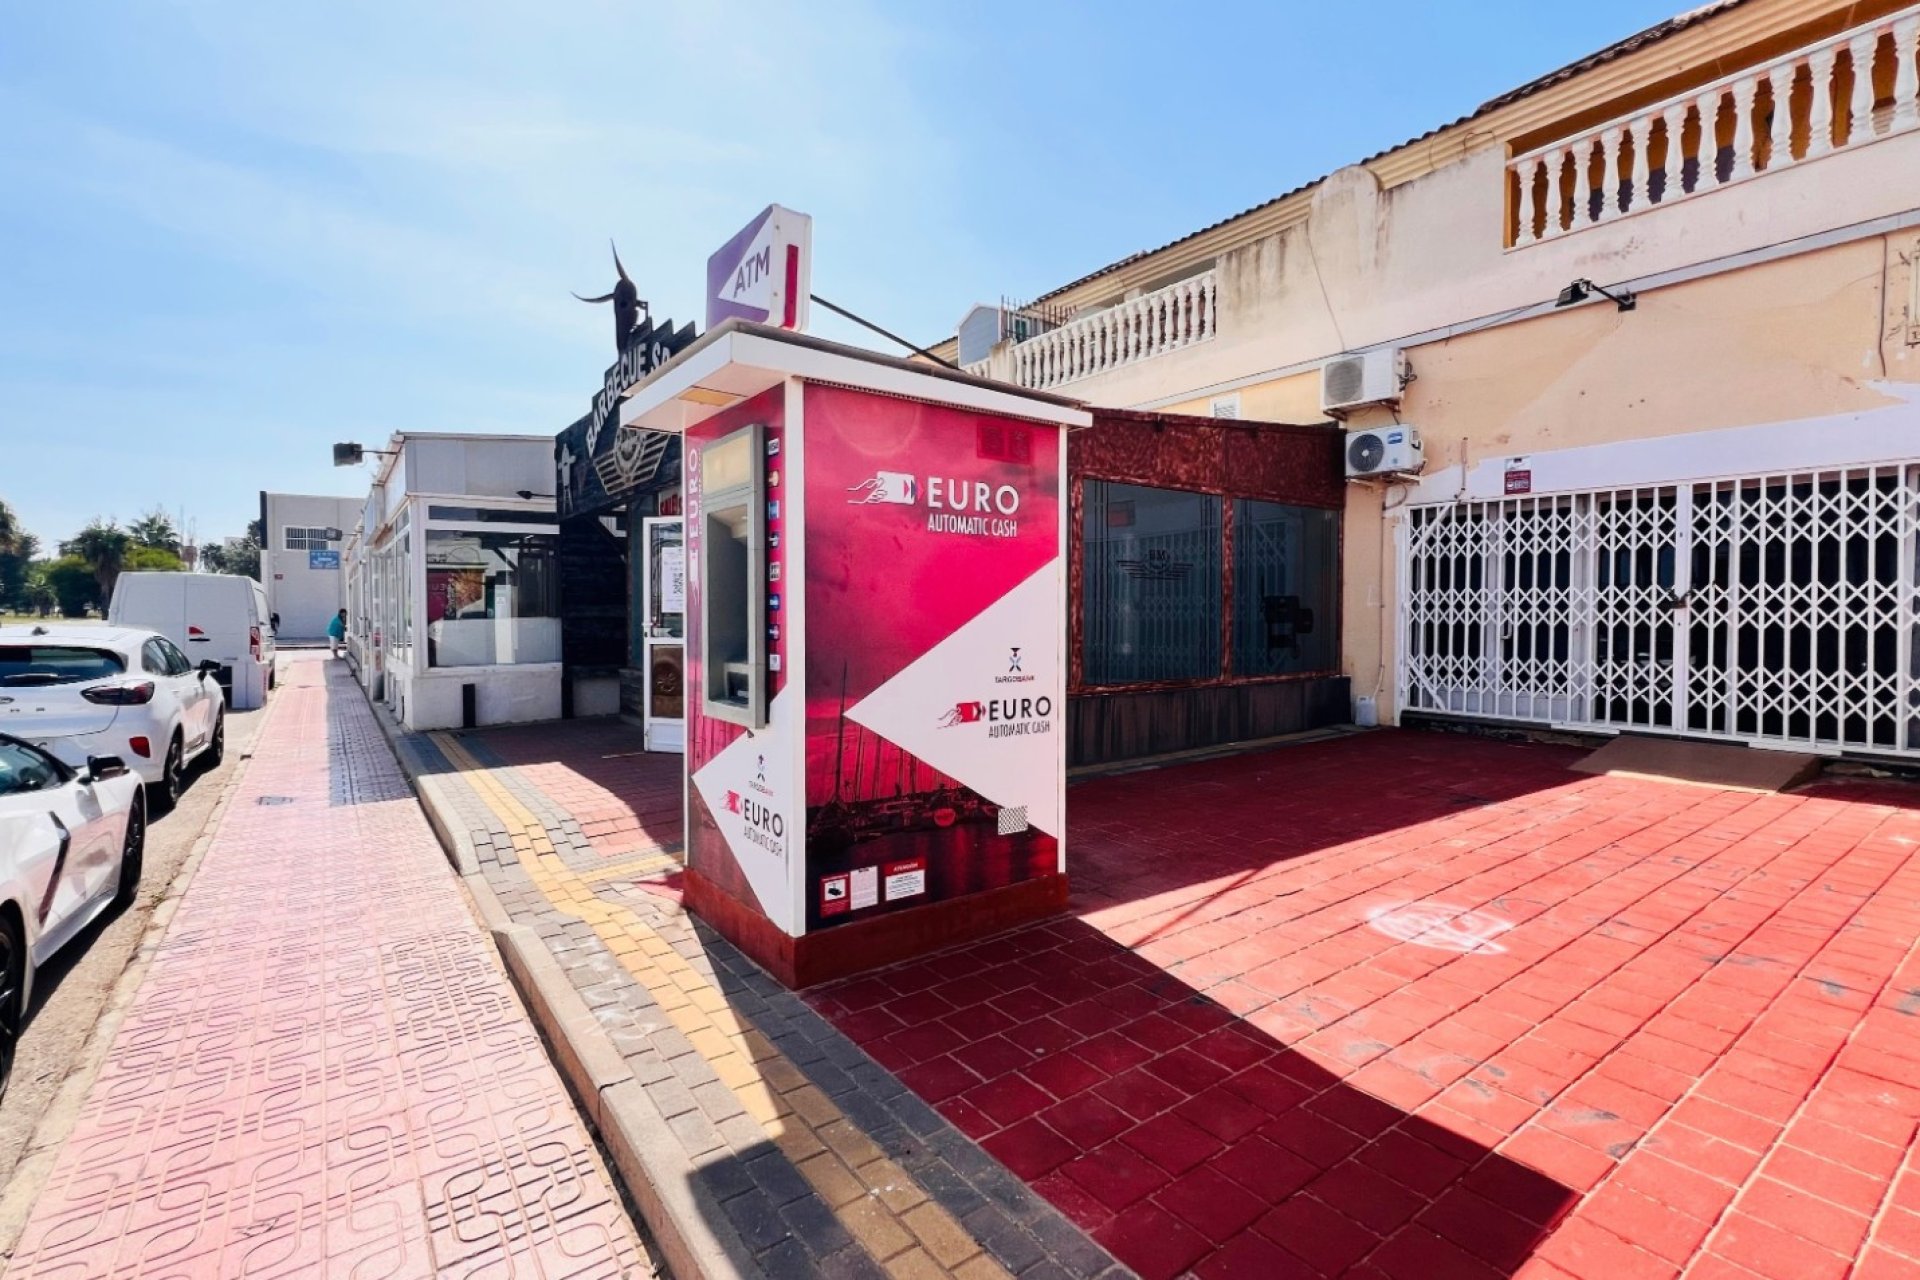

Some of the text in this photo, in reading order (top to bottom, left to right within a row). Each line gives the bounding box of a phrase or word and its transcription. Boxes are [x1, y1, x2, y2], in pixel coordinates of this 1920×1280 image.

[734, 245, 770, 298] ATM
[586, 343, 646, 458] BARBECUE
[689, 448, 699, 539] EURO
[928, 477, 1019, 515] EURO
[928, 513, 1017, 537] AUTOMATIC CASH
[989, 696, 1051, 721] EURO
[988, 720, 1050, 738] AUTOMATIC CASH
[744, 798, 784, 838] EURO
